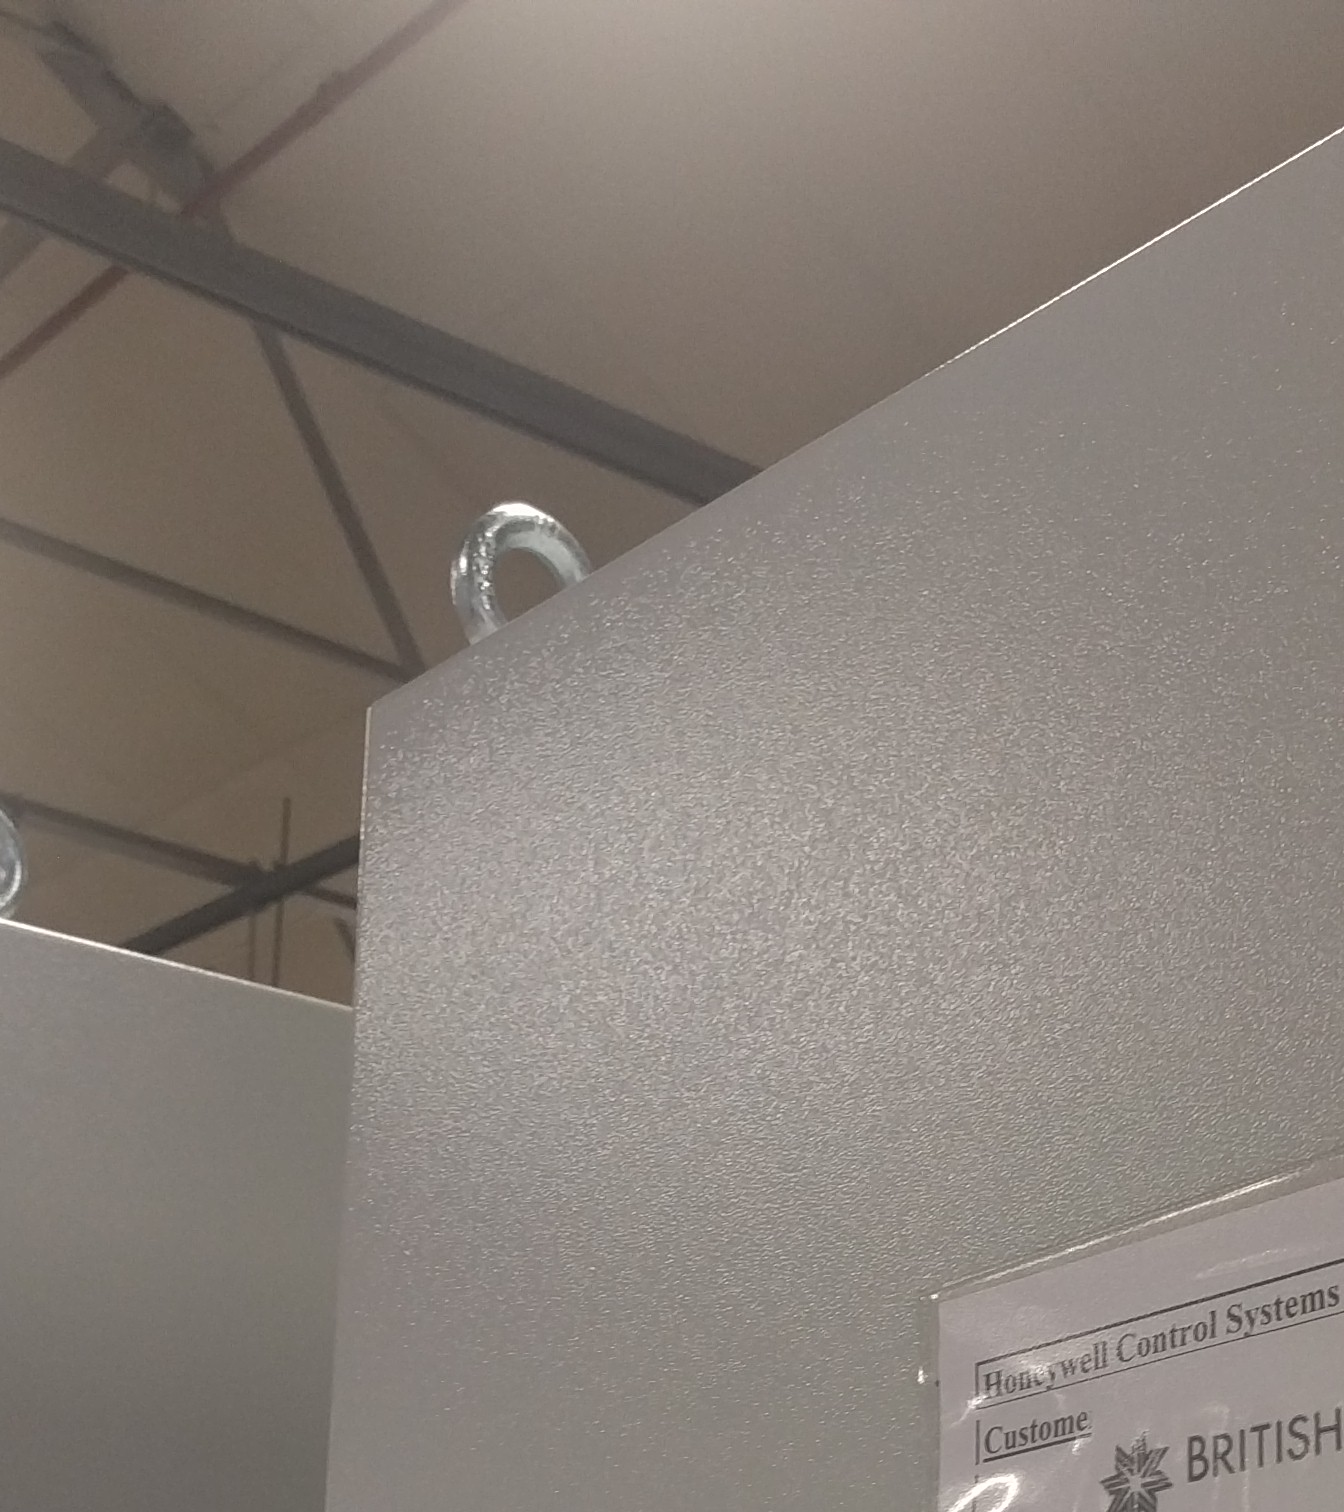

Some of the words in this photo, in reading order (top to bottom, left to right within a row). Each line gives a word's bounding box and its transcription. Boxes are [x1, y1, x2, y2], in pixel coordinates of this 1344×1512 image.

[1116, 1309, 1218, 1359] Control
[1225, 1284, 1341, 1337] Systems
[984, 1409, 1092, 1456] Custome
[1186, 1407, 1344, 1483] BRITISH
